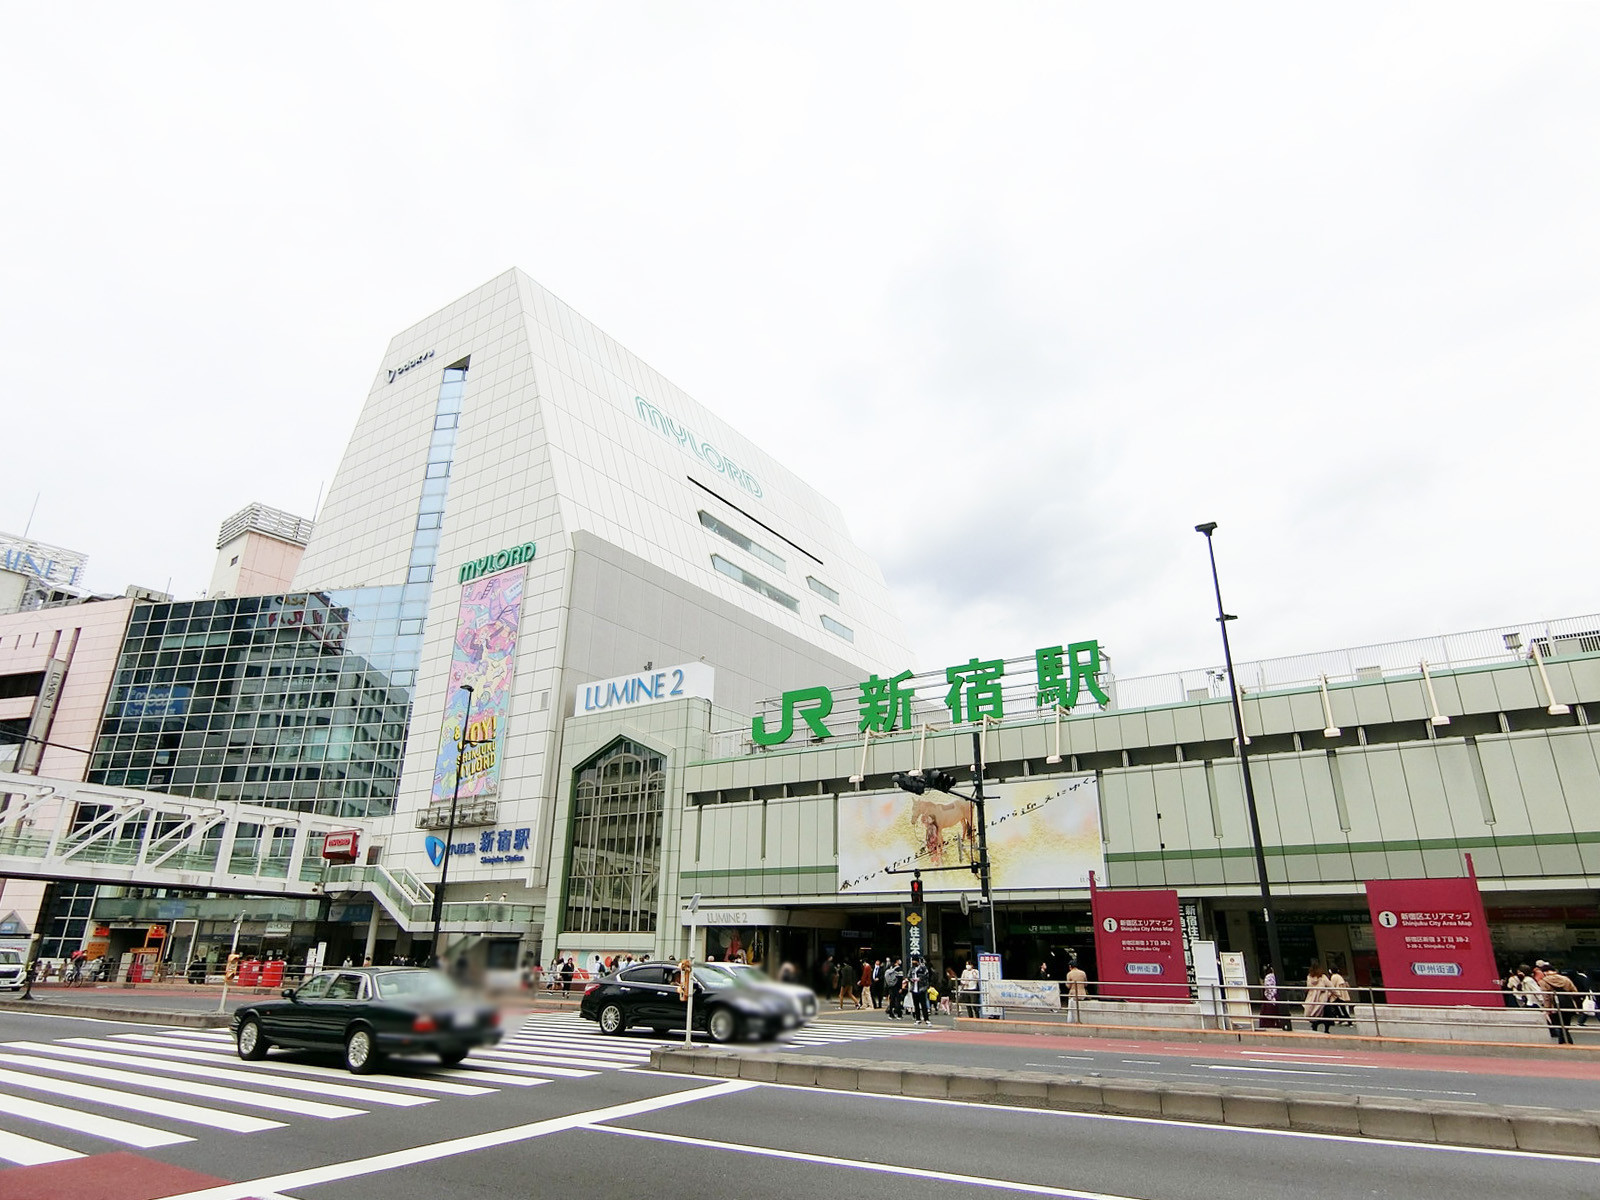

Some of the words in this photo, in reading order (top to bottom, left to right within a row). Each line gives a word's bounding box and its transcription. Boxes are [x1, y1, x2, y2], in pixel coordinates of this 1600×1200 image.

[635, 395, 763, 498] MYLORD
[458, 541, 536, 584] MYLORD
[584, 673, 666, 711] LUMINE
[669, 669, 684, 696] 2
[752, 685, 834, 746] JR
[858, 639, 1111, 733] 新宿駅
[479, 827, 531, 853] 新宿駅
[706, 912, 740, 924] LUMINE
[741, 912, 749, 924] 2
[1416, 965, 1456, 974] 甲州街道
